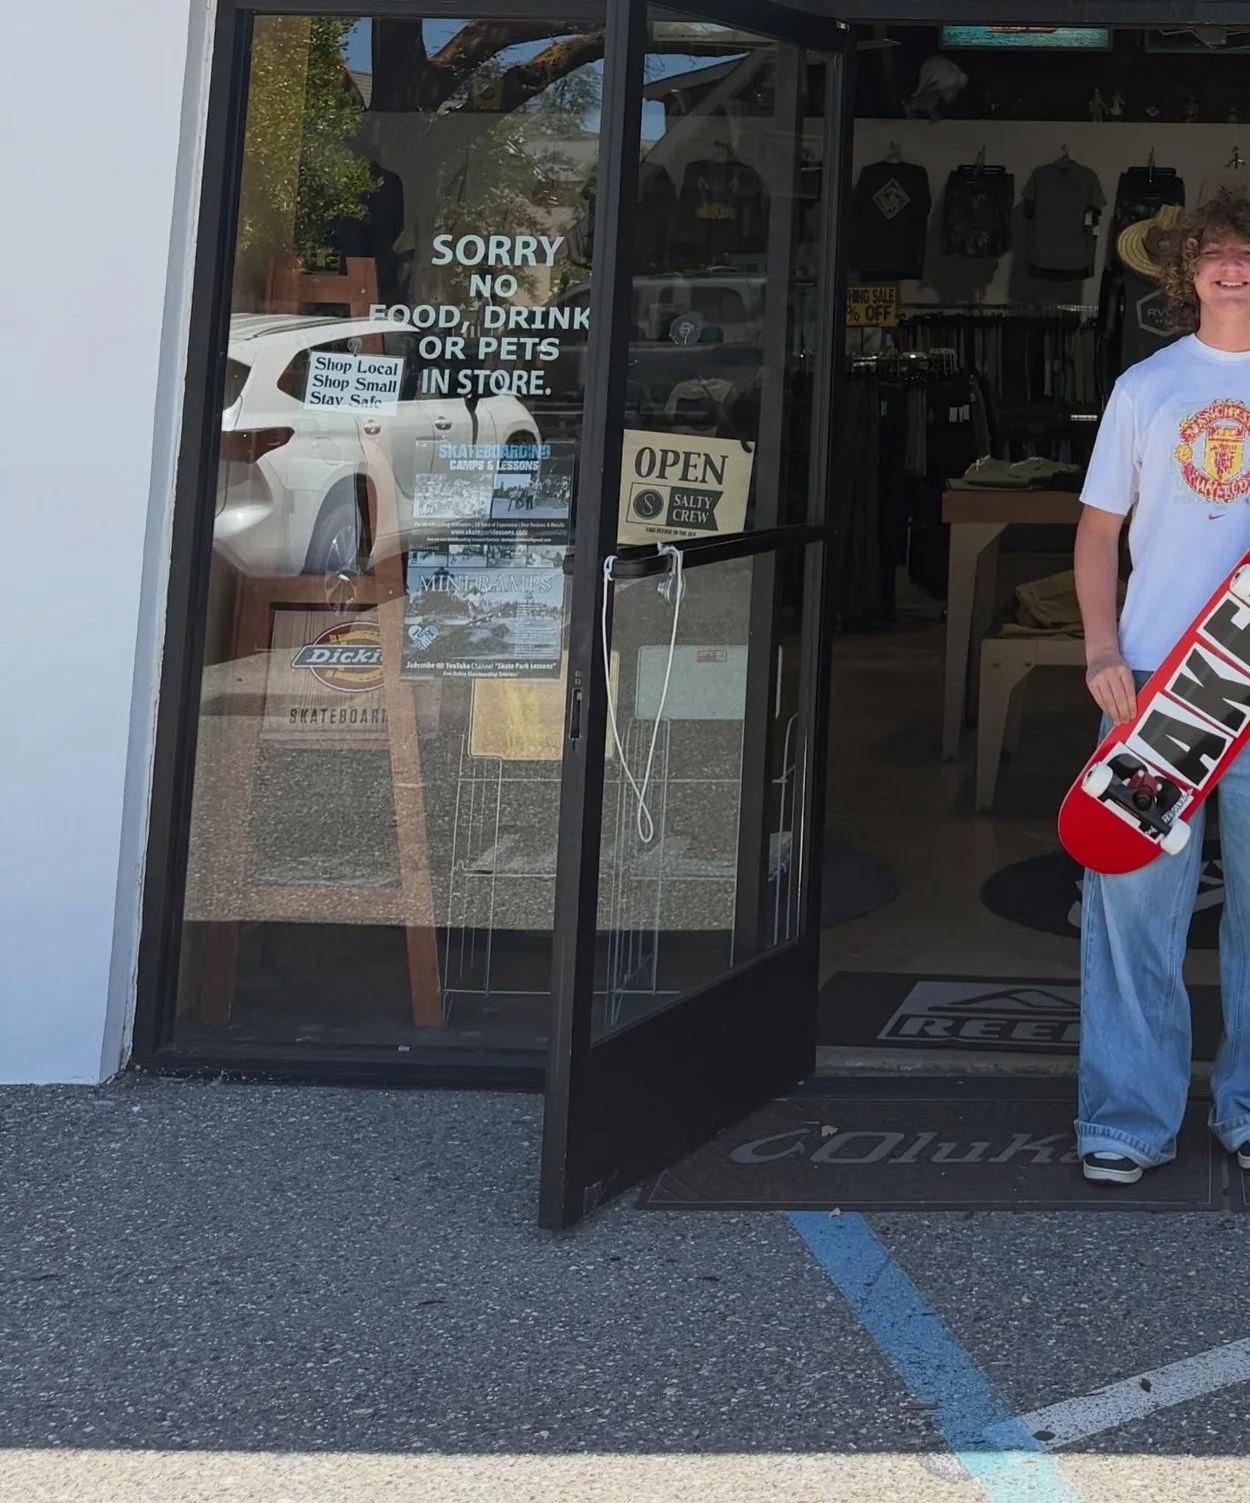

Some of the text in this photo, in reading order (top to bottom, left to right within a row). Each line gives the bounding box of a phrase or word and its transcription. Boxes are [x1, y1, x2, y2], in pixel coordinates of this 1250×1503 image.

[431, 234, 565, 267] SORRY
[469, 274, 518, 298] NO
[872, 288, 894, 304] SALE
[369, 304, 471, 334] FOOD,
[865, 304, 892, 321] OFF
[419, 336, 560, 361] OR PETS
[314, 356, 398, 376] Shop Local
[312, 374, 397, 393] Shop Small
[421, 368, 552, 396] IN STORE.
[449, 459, 484, 472] CAMPS
[496, 459, 540, 472] LESSONS
[634, 446, 729, 485] OPEN
[673, 494, 713, 509] SALTY
[672, 509, 710, 524] CREW
[419, 574, 552, 594] MINI RAMPS
[305, 648, 382, 663] Dicki
[811, 1130, 1079, 1165] OluK
